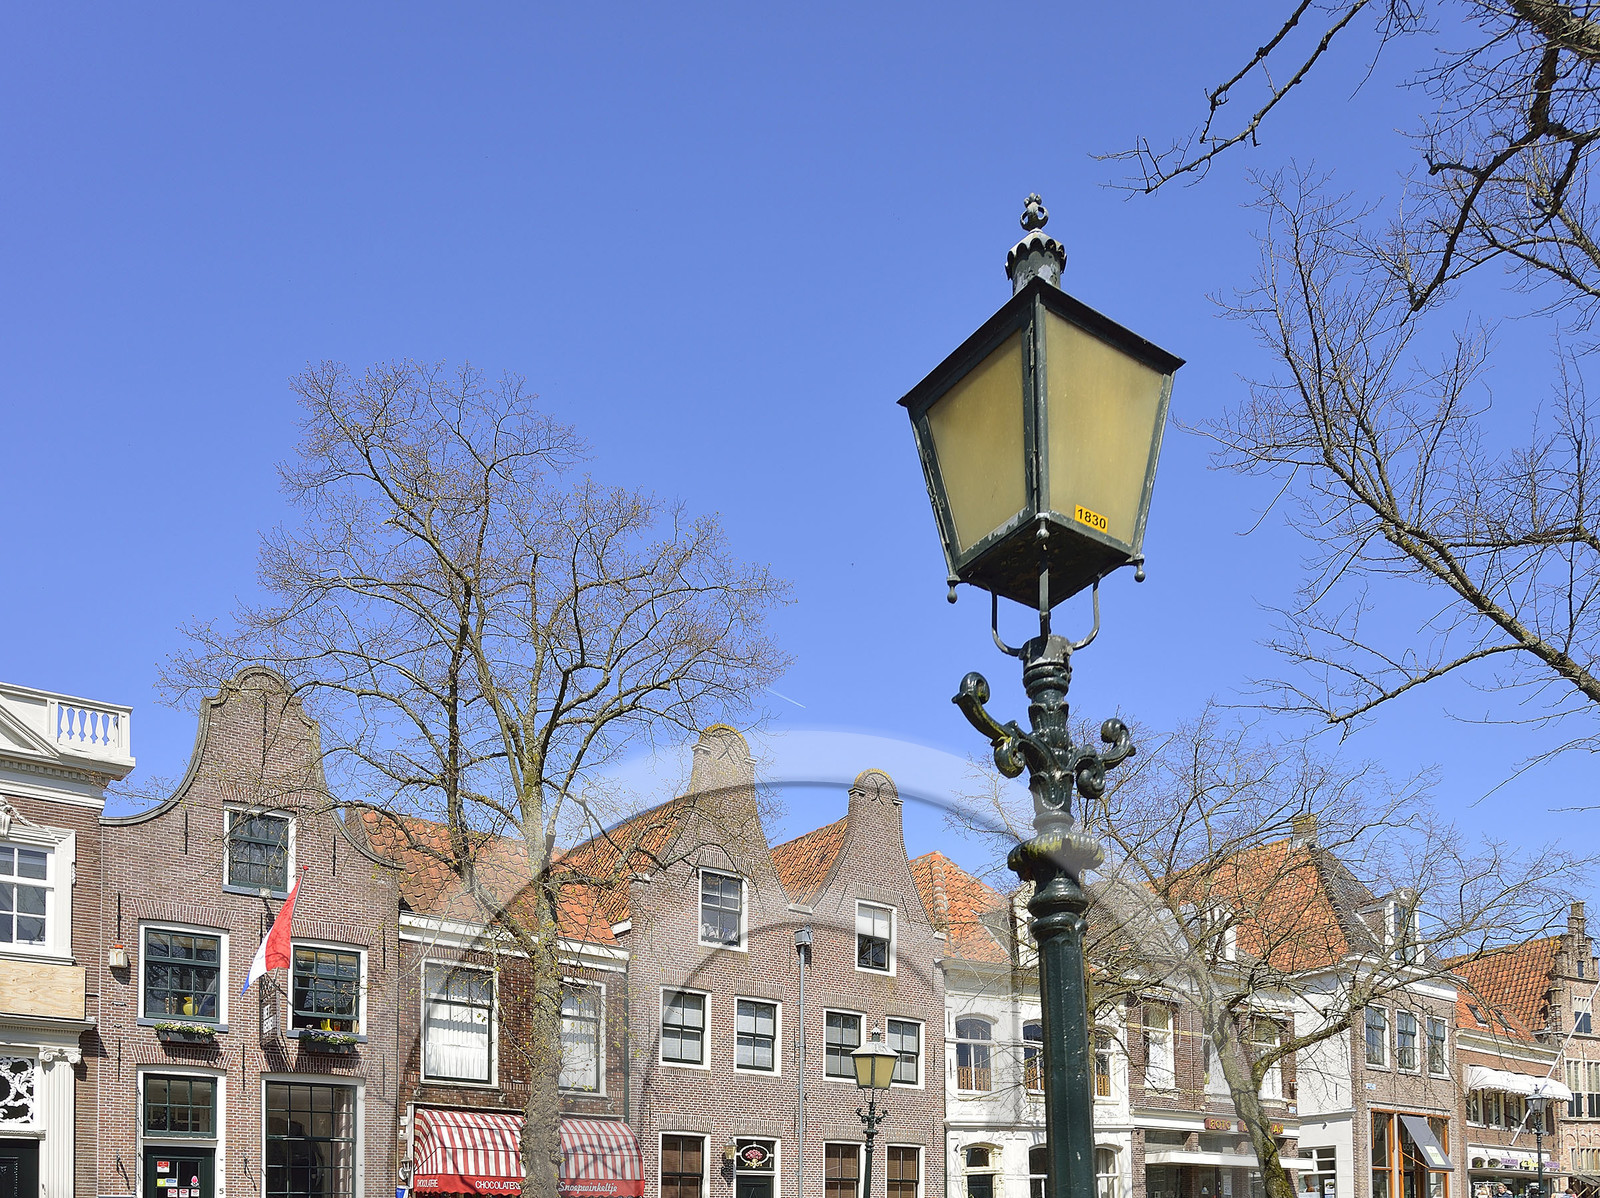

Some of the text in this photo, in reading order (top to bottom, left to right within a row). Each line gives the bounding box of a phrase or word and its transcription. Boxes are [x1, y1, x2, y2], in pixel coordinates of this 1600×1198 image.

[1077, 508, 1107, 529] 1830
[475, 1180, 521, 1190] CHOCOLATER
[558, 1181, 618, 1195] Snoepwinkeltje
